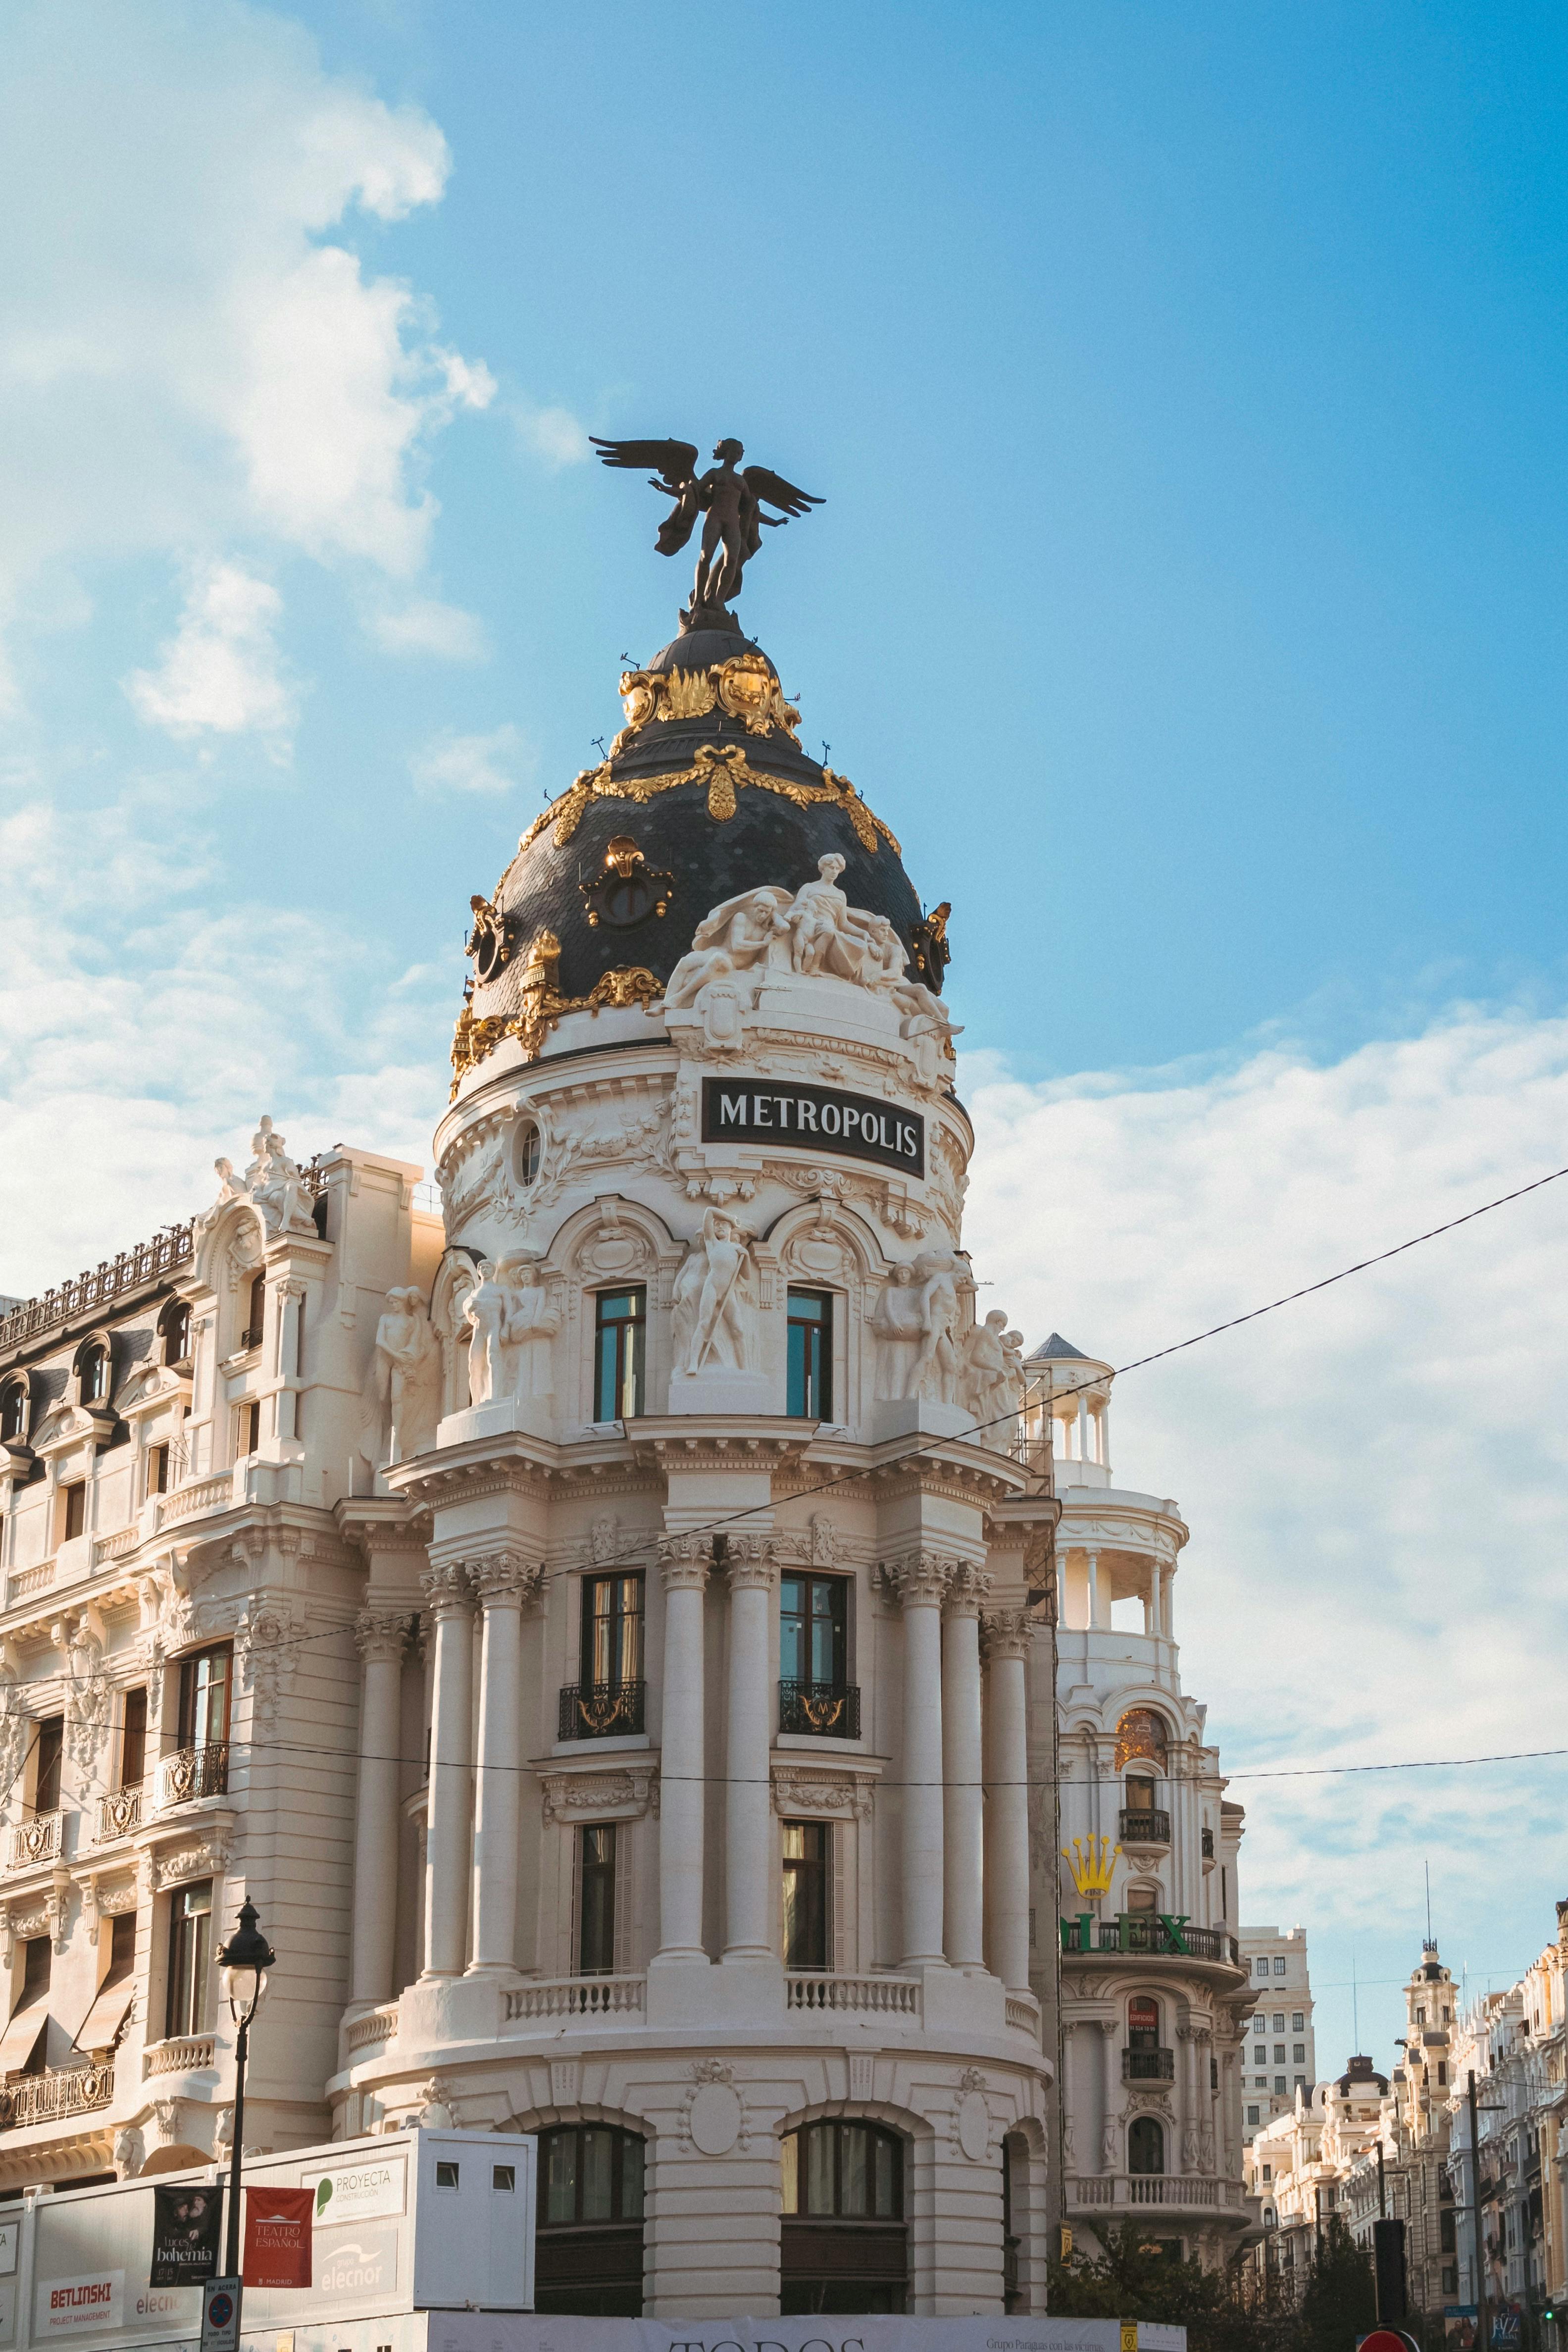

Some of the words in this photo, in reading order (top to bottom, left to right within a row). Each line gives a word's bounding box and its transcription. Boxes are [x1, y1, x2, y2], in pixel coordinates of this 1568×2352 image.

[720, 1094, 917, 1157] METROPOLIS
[1060, 1418, 1194, 1461] LEX
[337, 2170, 391, 2192] PROYECTA
[336, 2189, 379, 2202] CONSTRUCCIÓN
[255, 2225, 301, 2238] TEATRO
[255, 2237, 305, 2249] ESPAÑOL
[157, 2246, 212, 2262] bohemia
[321, 2265, 383, 2292] elecnor
[51, 2283, 112, 2309] BETLINSKI
[50, 2315, 73, 2326] PROJECT
[74, 2310, 111, 2323] MANAGEMENT
[986, 2338, 1014, 2352] Grupo
[1015, 2339, 1048, 2352] Paraguas
[1049, 2342, 1062, 2351] con
[1064, 2340, 1073, 2351] las
